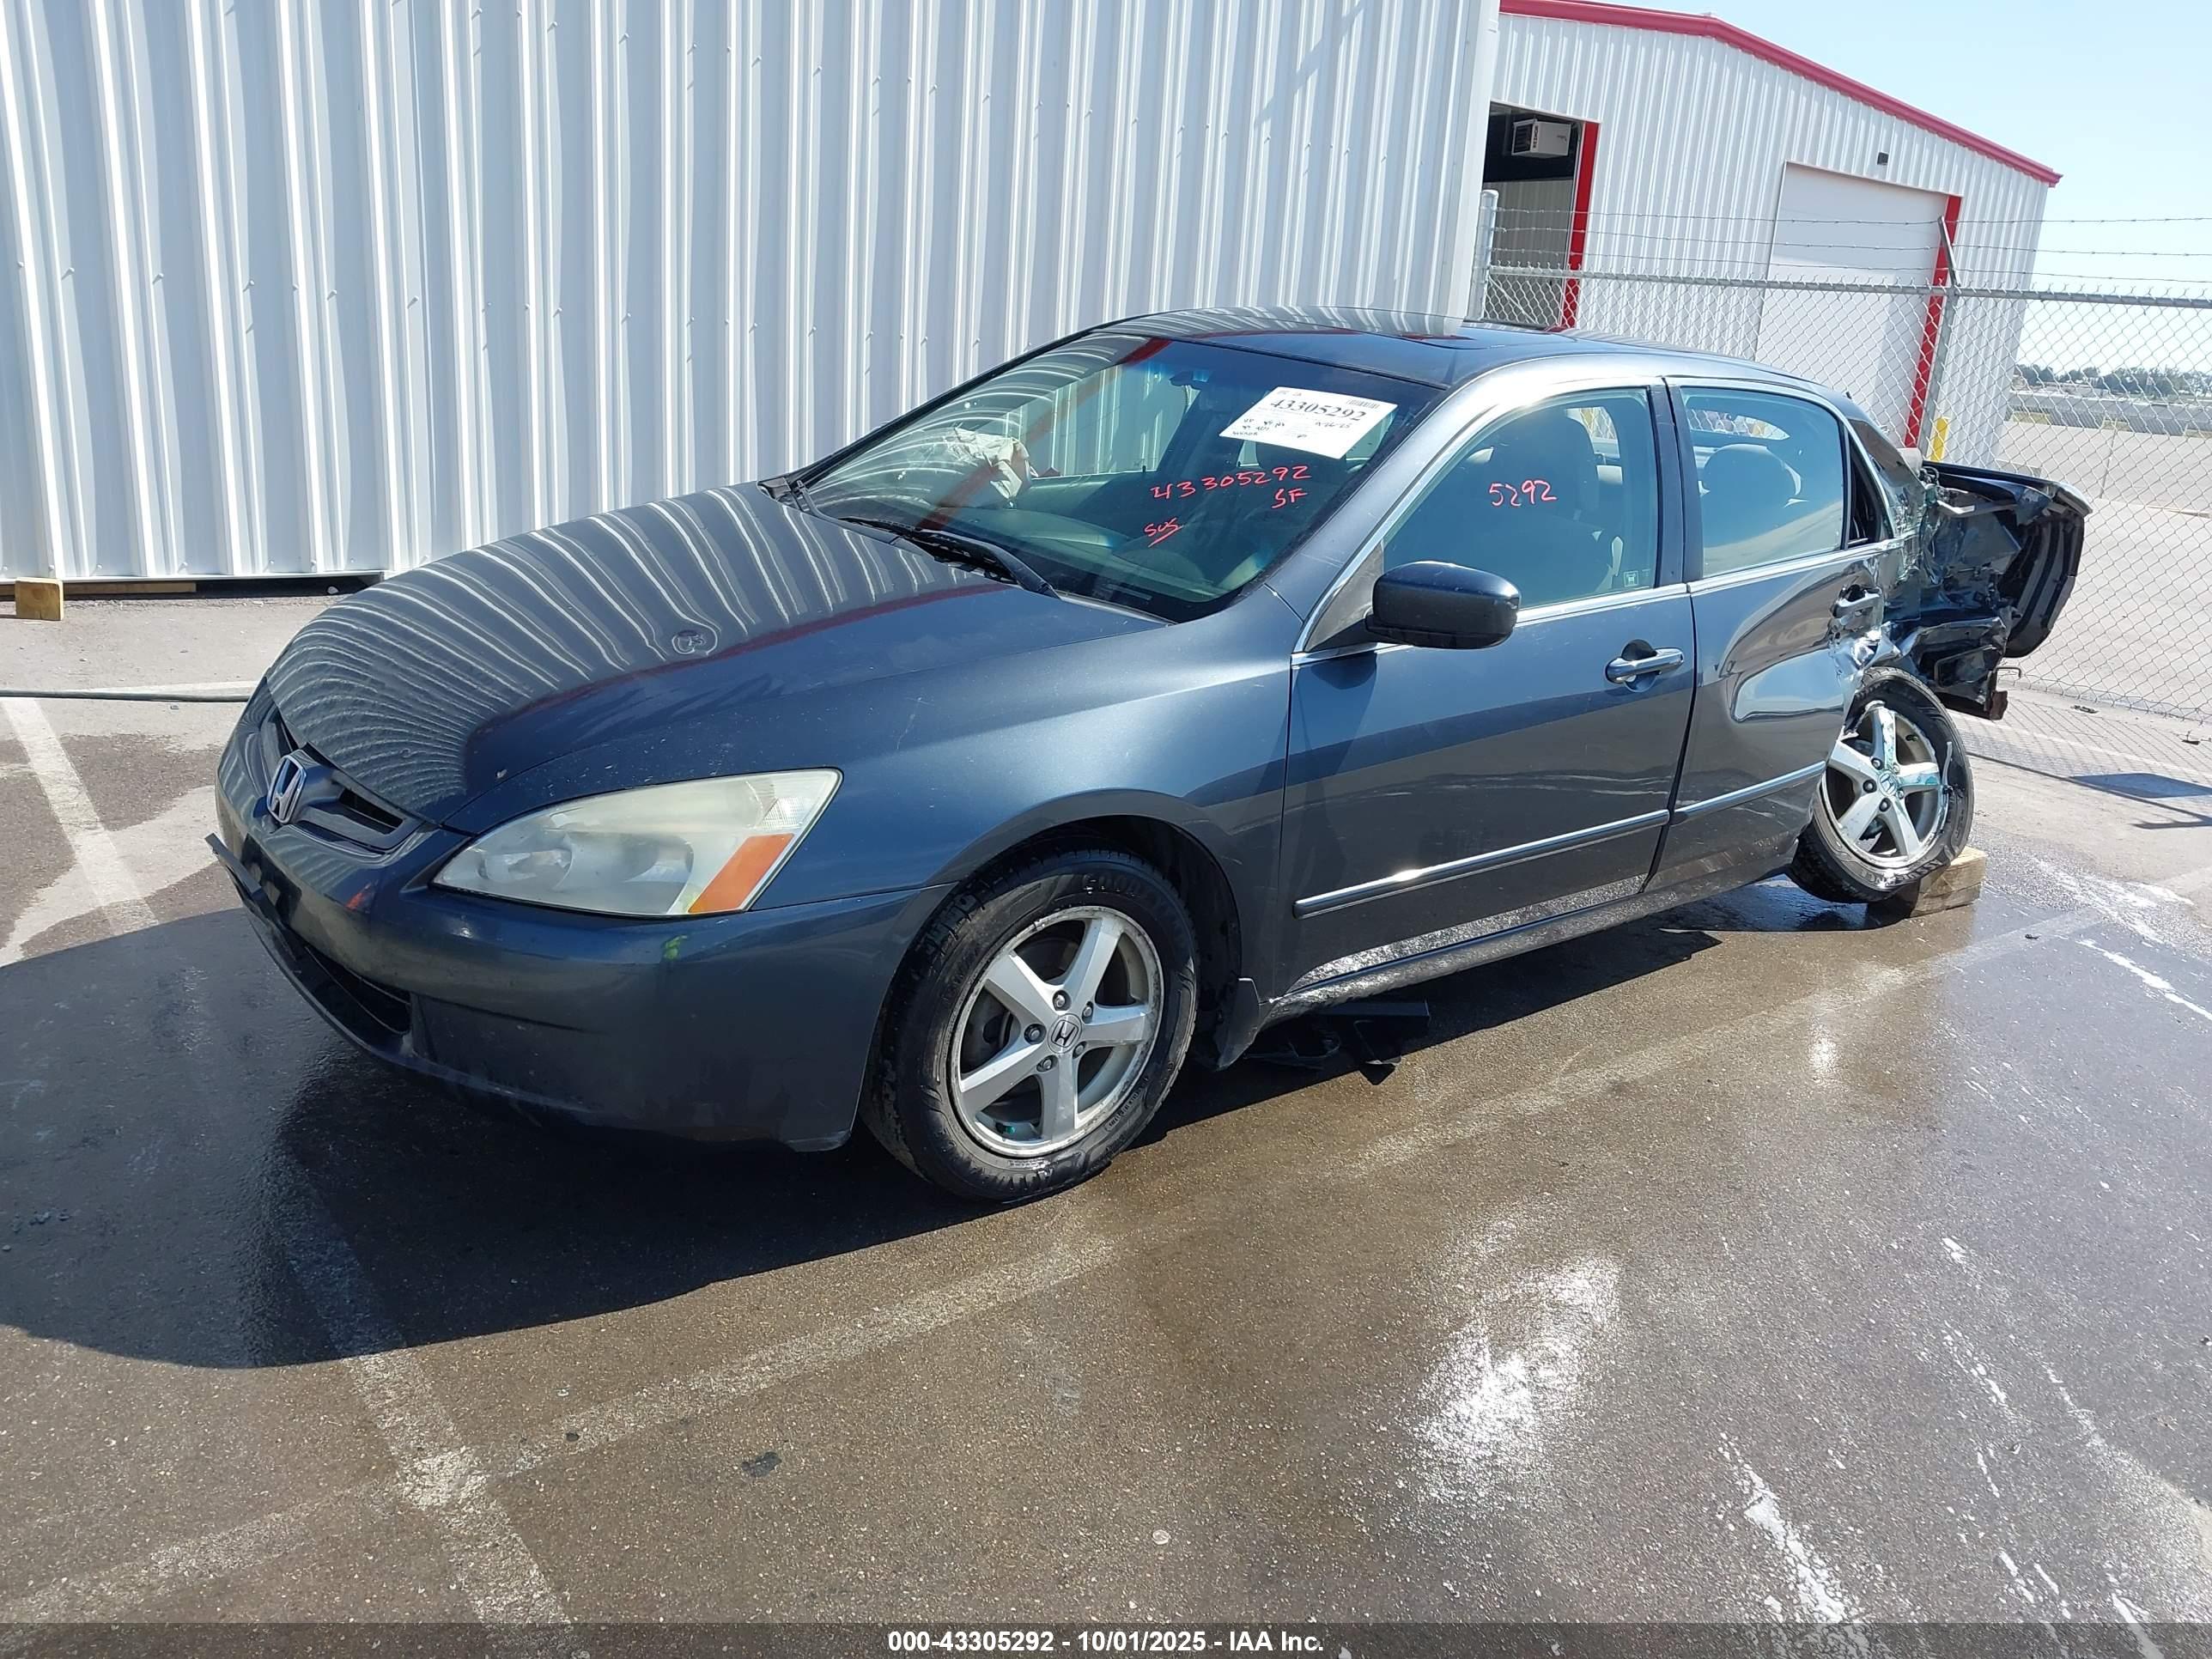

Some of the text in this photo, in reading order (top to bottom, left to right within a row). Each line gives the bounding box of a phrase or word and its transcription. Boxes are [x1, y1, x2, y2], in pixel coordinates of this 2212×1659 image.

[1271, 398, 1366, 421] 43305292
[1150, 465, 1312, 501] 43305292
[1489, 479, 1558, 507] 5292
